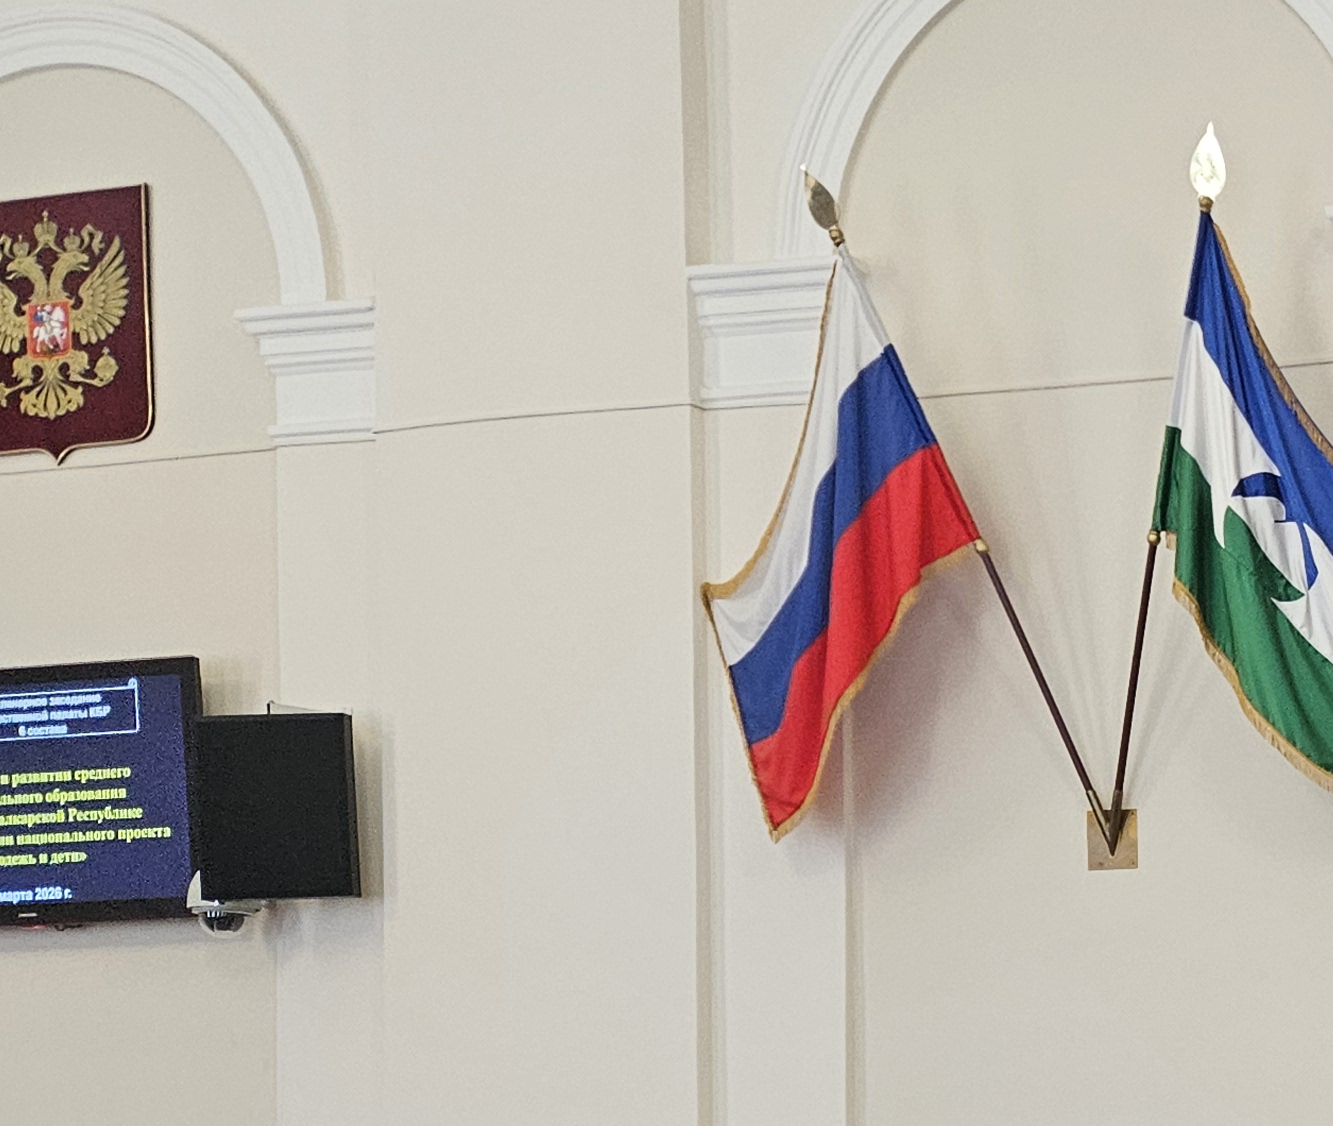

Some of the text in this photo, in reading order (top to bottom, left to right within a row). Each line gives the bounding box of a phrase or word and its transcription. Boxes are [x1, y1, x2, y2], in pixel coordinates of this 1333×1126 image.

[89, 706, 111, 718] КБР
[12, 769, 72, 787] развитии
[74, 767, 131, 783] среднего
[45, 787, 127, 805] образования
[68, 806, 144, 824] Республике
[16, 829, 115, 845] национального
[117, 826, 172, 843] проекта
[35, 886, 62, 900] 2026
